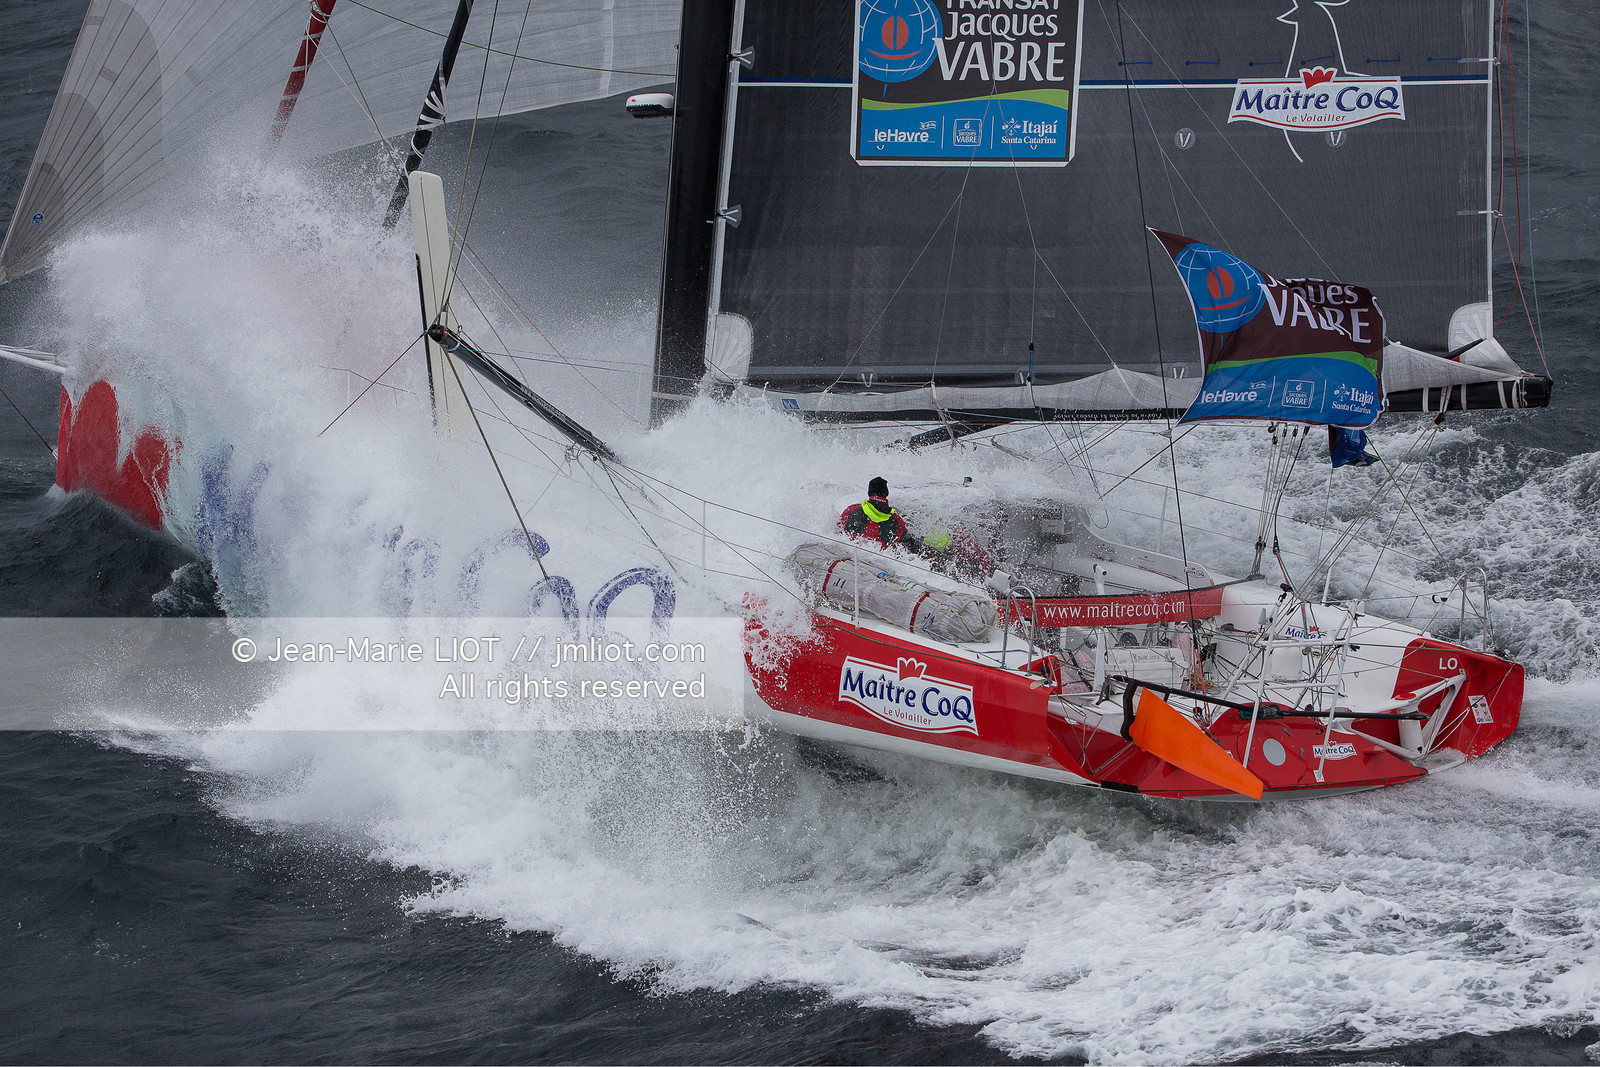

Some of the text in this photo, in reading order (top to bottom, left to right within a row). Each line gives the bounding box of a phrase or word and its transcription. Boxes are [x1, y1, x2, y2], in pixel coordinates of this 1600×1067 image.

[932, 38, 1066, 81] VABRE
[1235, 86, 1400, 114] Maître CoQ
[1286, 113, 1346, 123] Le Volailler
[874, 128, 930, 142] leHavre
[1022, 120, 1058, 137] Itajaí
[956, 136, 978, 144] VABRE
[1001, 136, 1057, 144] Santa Catarina
[1257, 283, 1371, 343] VARE
[1201, 389, 1258, 403] leHavre
[1285, 396, 1308, 405] VABRE
[1331, 401, 1350, 411] Santa
[1438, 657, 1459, 670] LO
[843, 667, 974, 724] Maître CoQ
[883, 706, 932, 726] Le Volailler
[1338, 745, 1355, 755] CoQ
